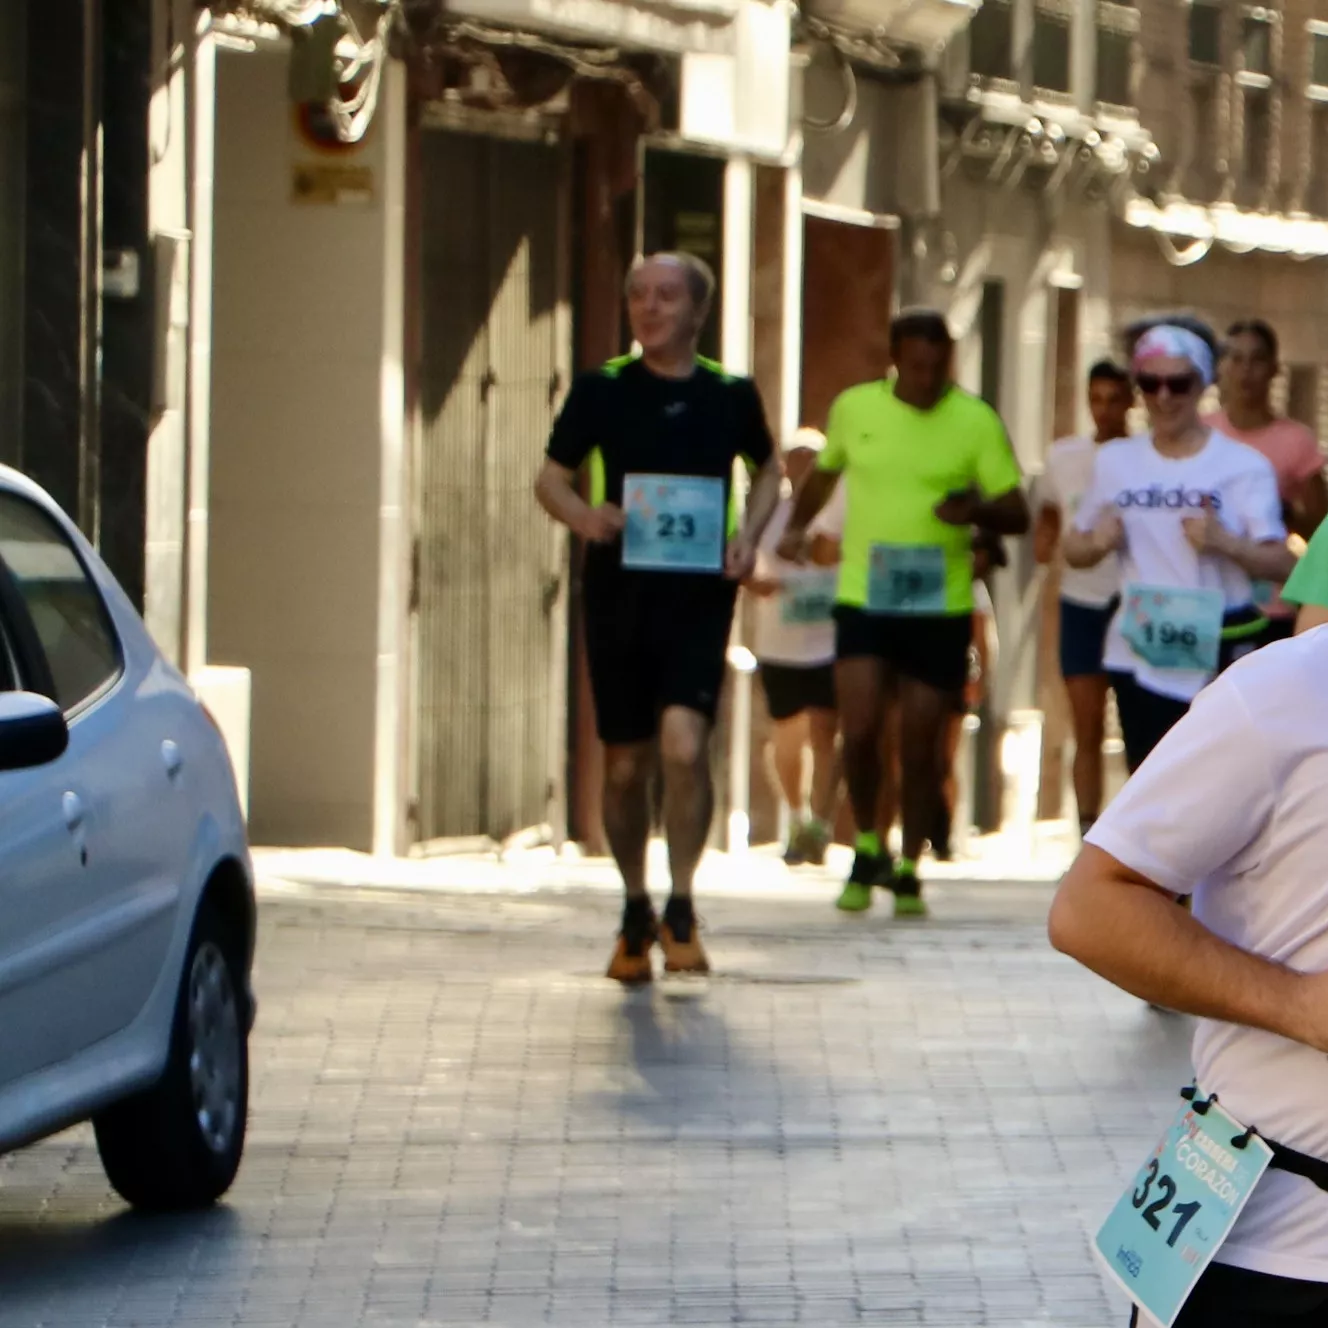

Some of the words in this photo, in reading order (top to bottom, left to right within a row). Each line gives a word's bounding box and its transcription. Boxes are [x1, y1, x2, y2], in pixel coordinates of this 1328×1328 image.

[1116, 485, 1223, 511] adidas
[656, 513, 696, 539] 23
[1131, 1158, 1203, 1248] 321
